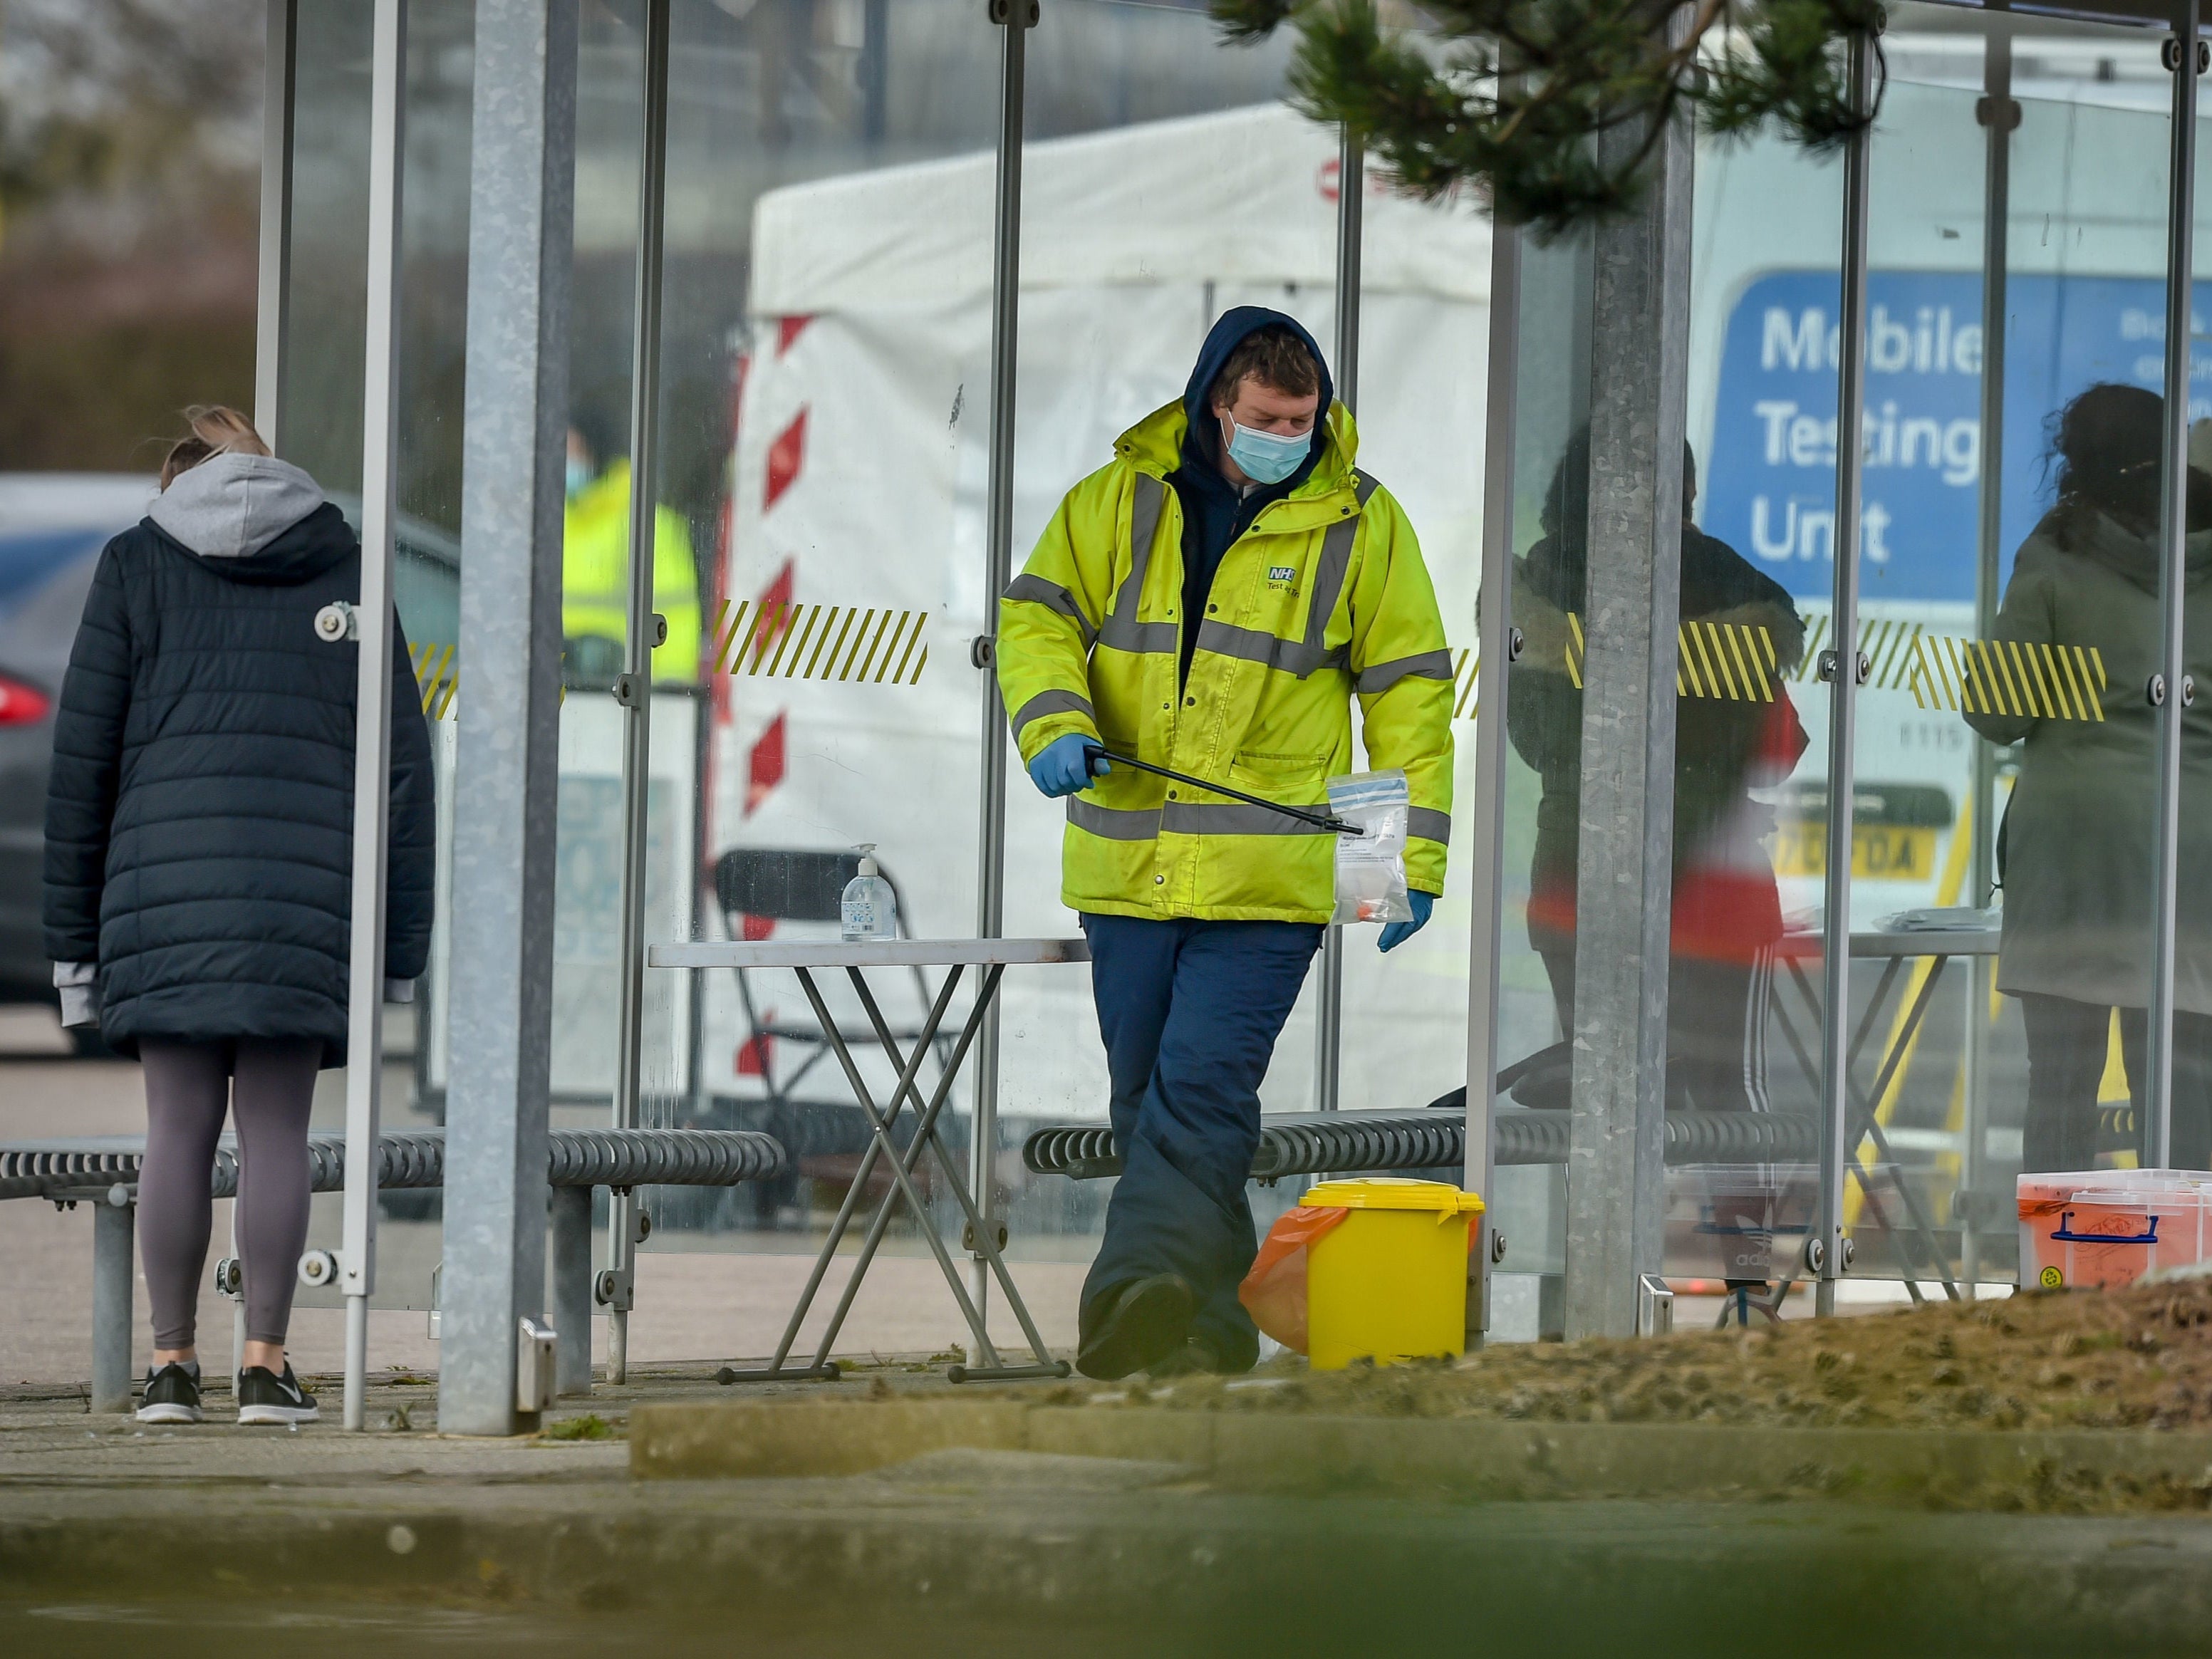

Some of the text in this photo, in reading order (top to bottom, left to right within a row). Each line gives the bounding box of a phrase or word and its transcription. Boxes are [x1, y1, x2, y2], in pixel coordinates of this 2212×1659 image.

[1760, 304, 1983, 375] Mbile
[1752, 495, 1891, 563] Unt
[1269, 568, 1295, 581] NHS
